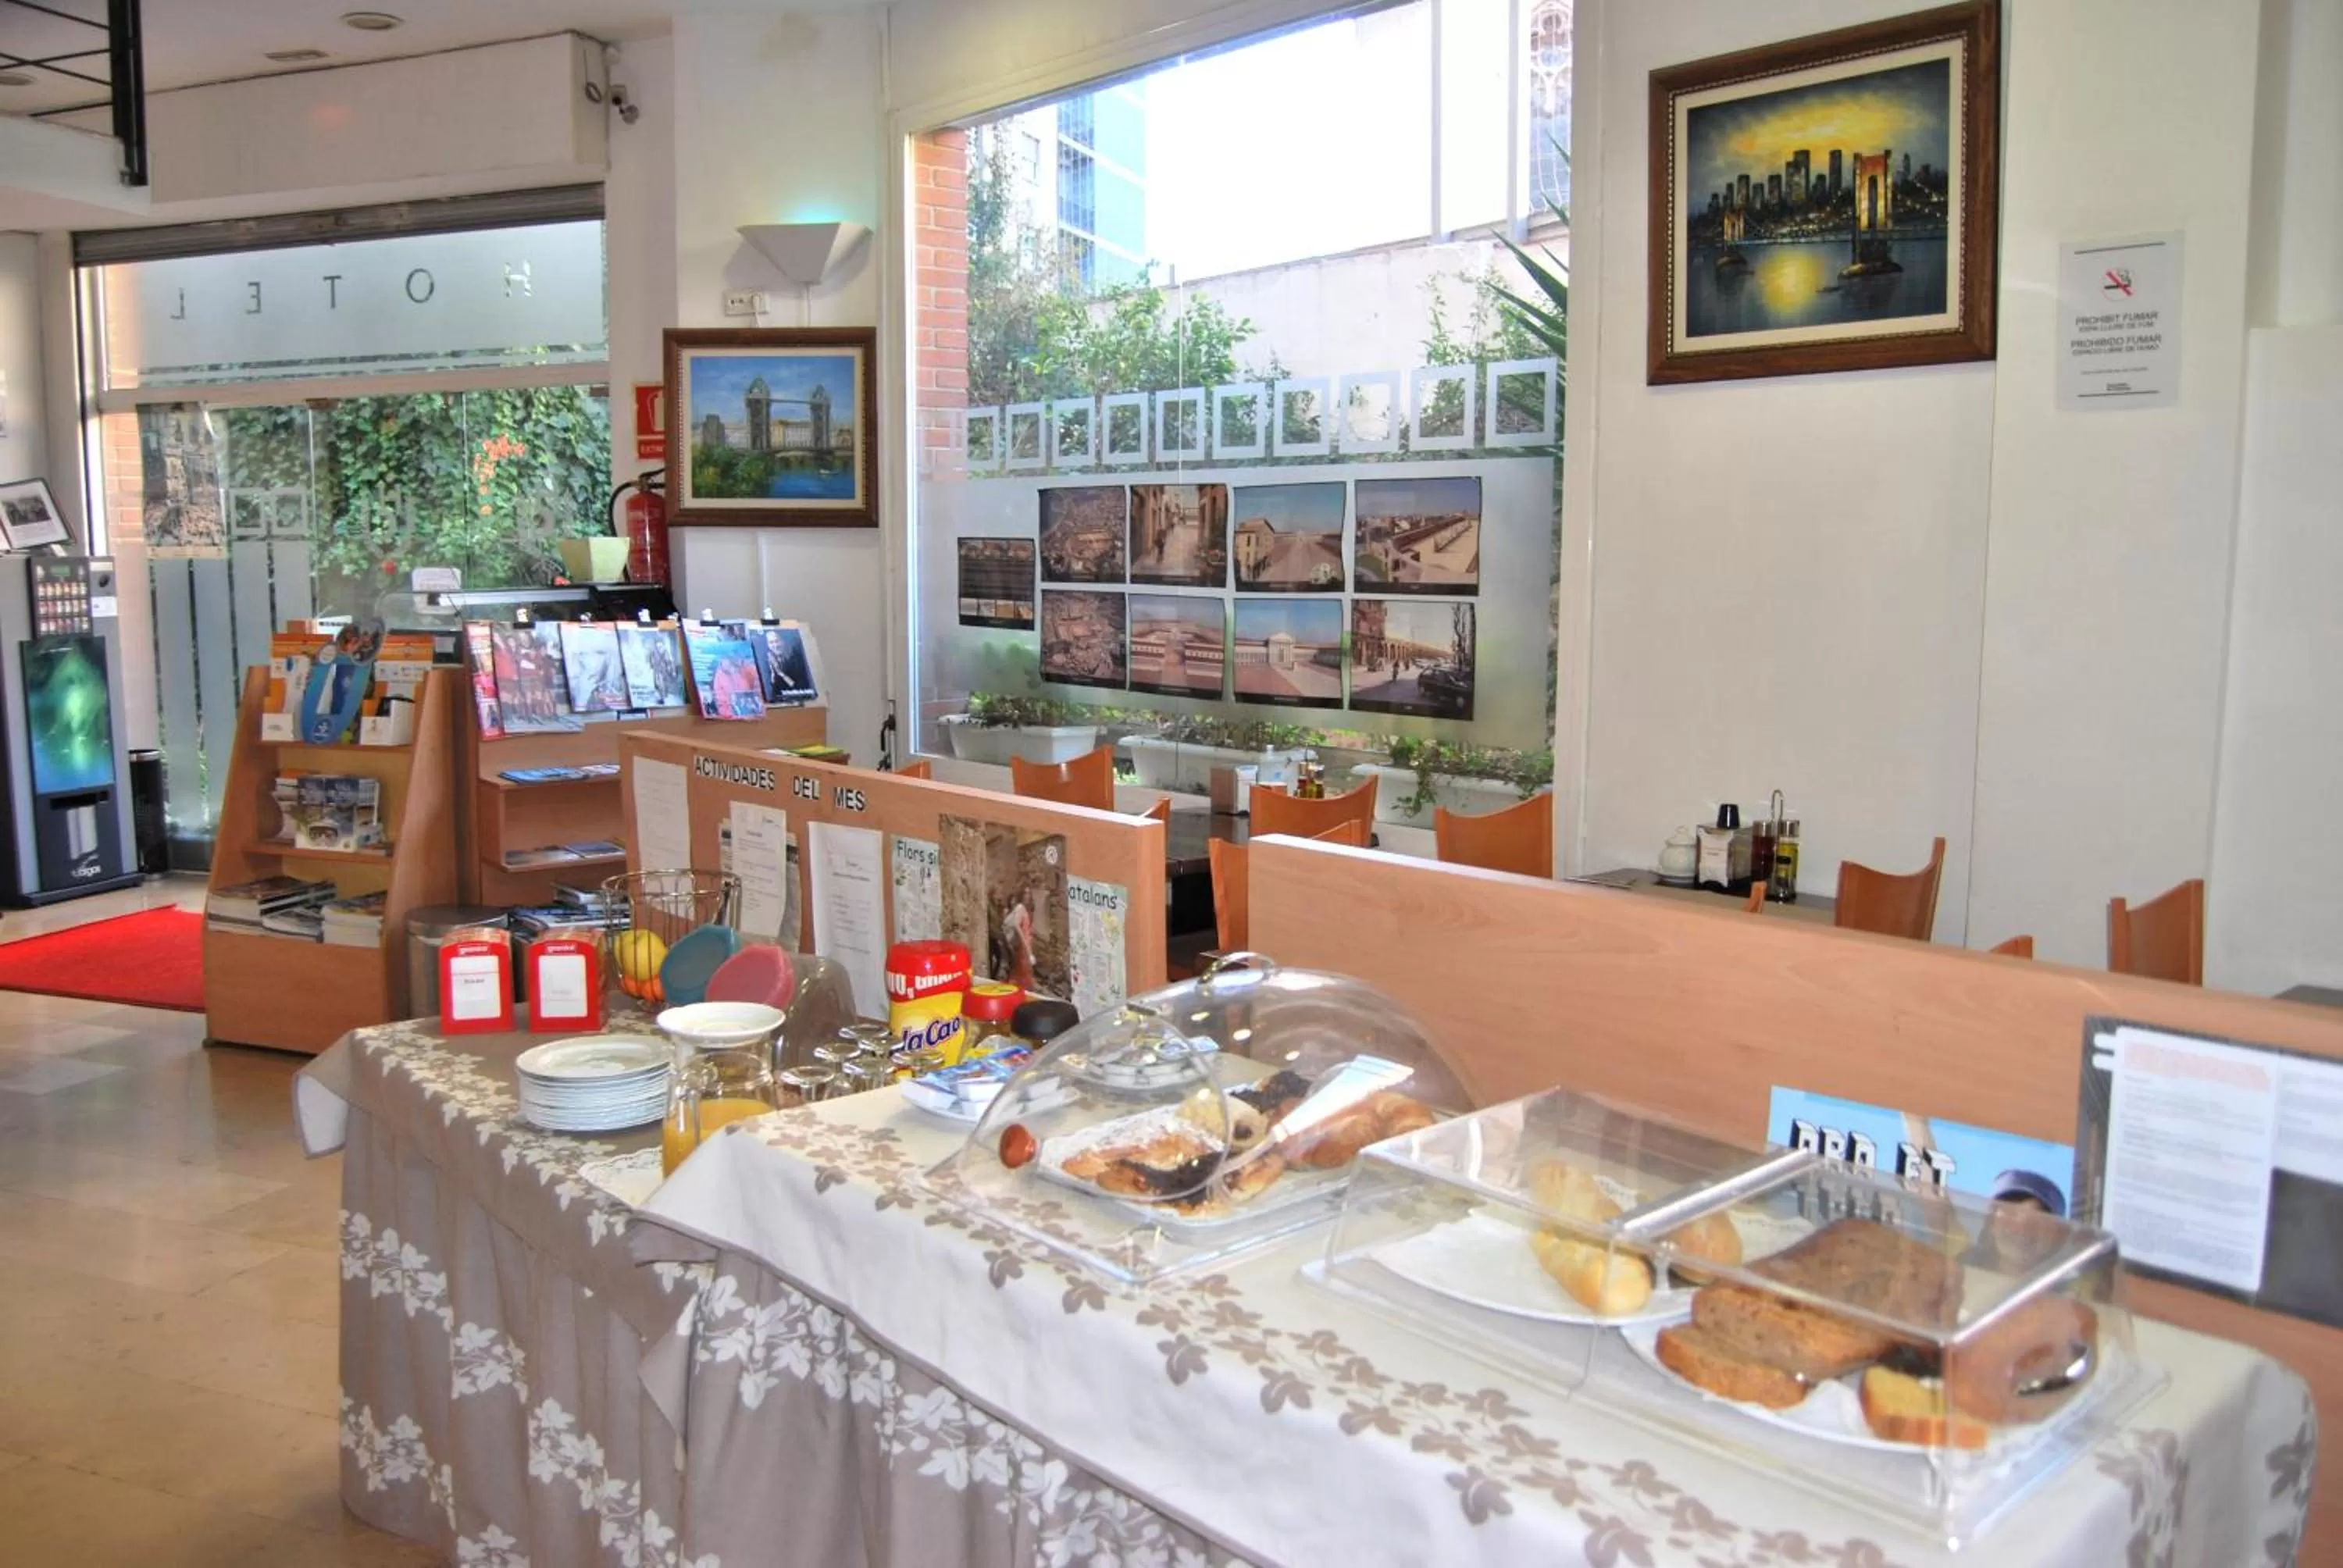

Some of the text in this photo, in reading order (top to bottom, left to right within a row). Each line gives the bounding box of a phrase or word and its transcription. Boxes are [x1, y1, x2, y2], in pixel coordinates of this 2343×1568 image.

[2127, 333, 2162, 345] FUMAR
[694, 755, 866, 811] ACTIVIDADES DEL MES
[897, 839, 925, 863] Flors
[1068, 885, 1118, 910] atalans
